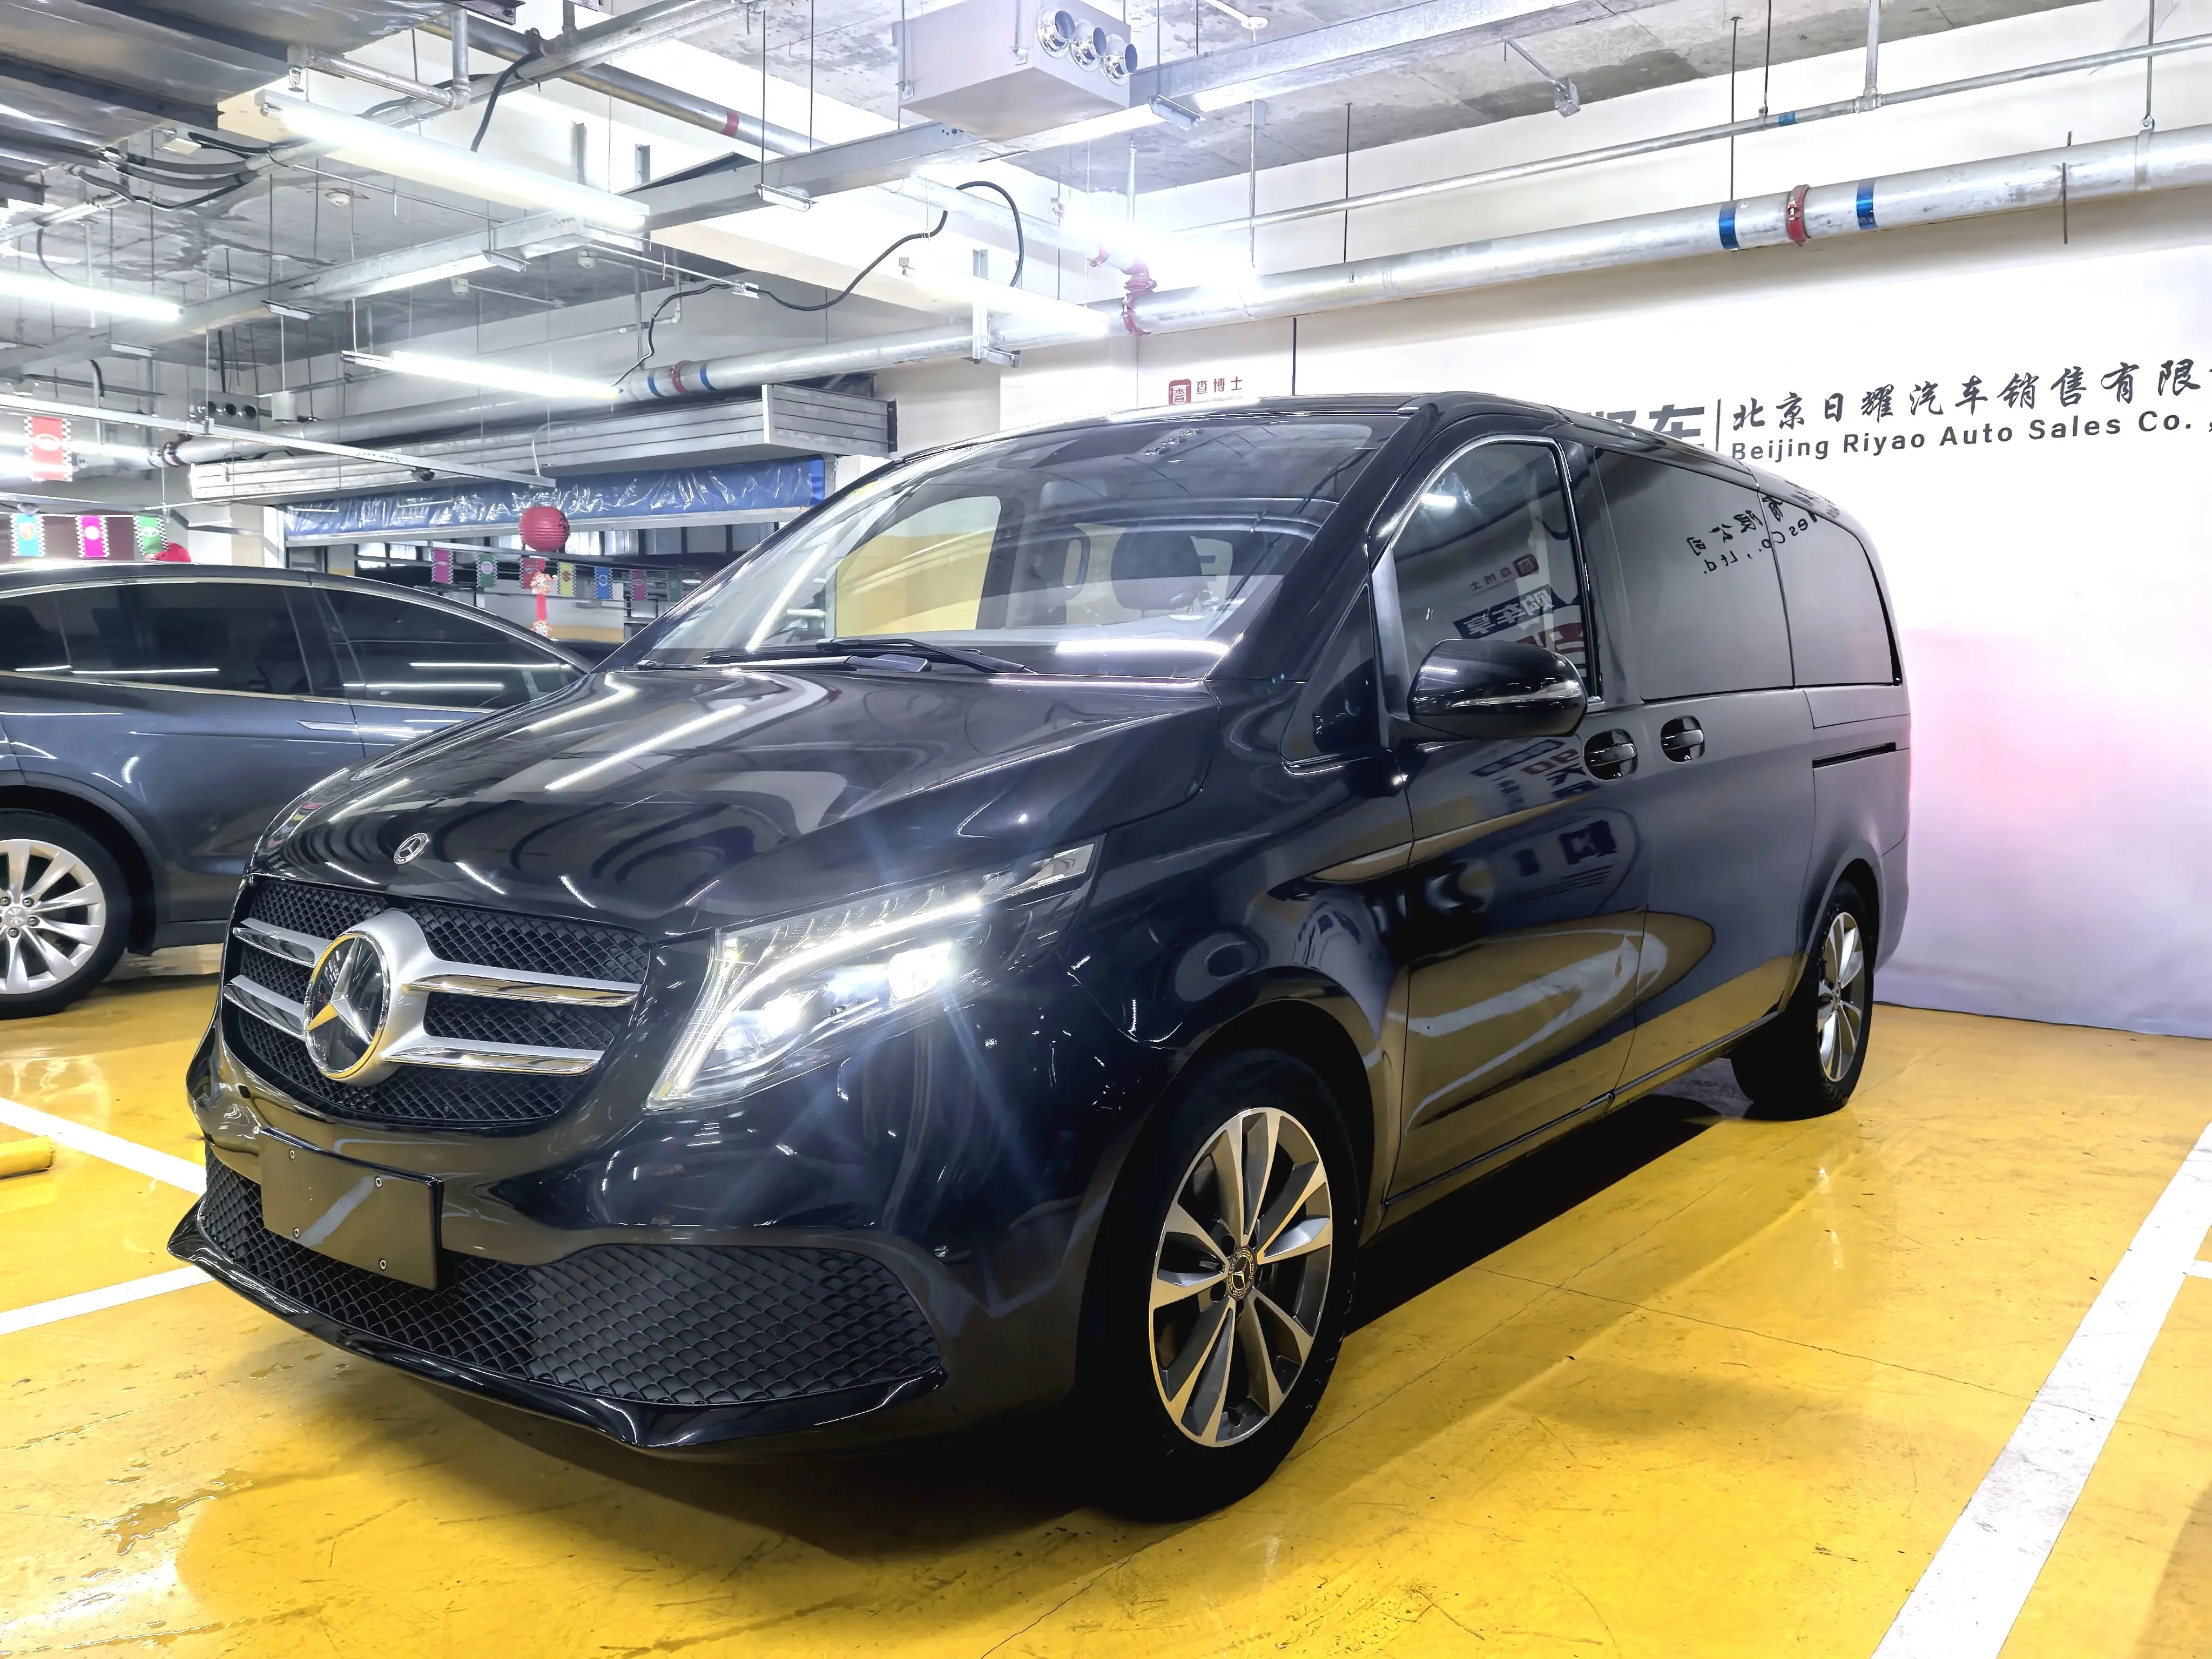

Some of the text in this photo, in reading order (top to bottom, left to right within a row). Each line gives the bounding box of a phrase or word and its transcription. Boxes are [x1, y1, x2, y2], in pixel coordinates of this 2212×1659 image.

[1196, 376, 1243, 395] 查博士
[1732, 359, 2212, 431] 北京日耀汽车销售有限
[1732, 438, 1829, 463] Beijing
[1843, 433, 1925, 456] Riyao
[1940, 423, 2013, 446] Auto
[2028, 415, 2121, 440] Sales
